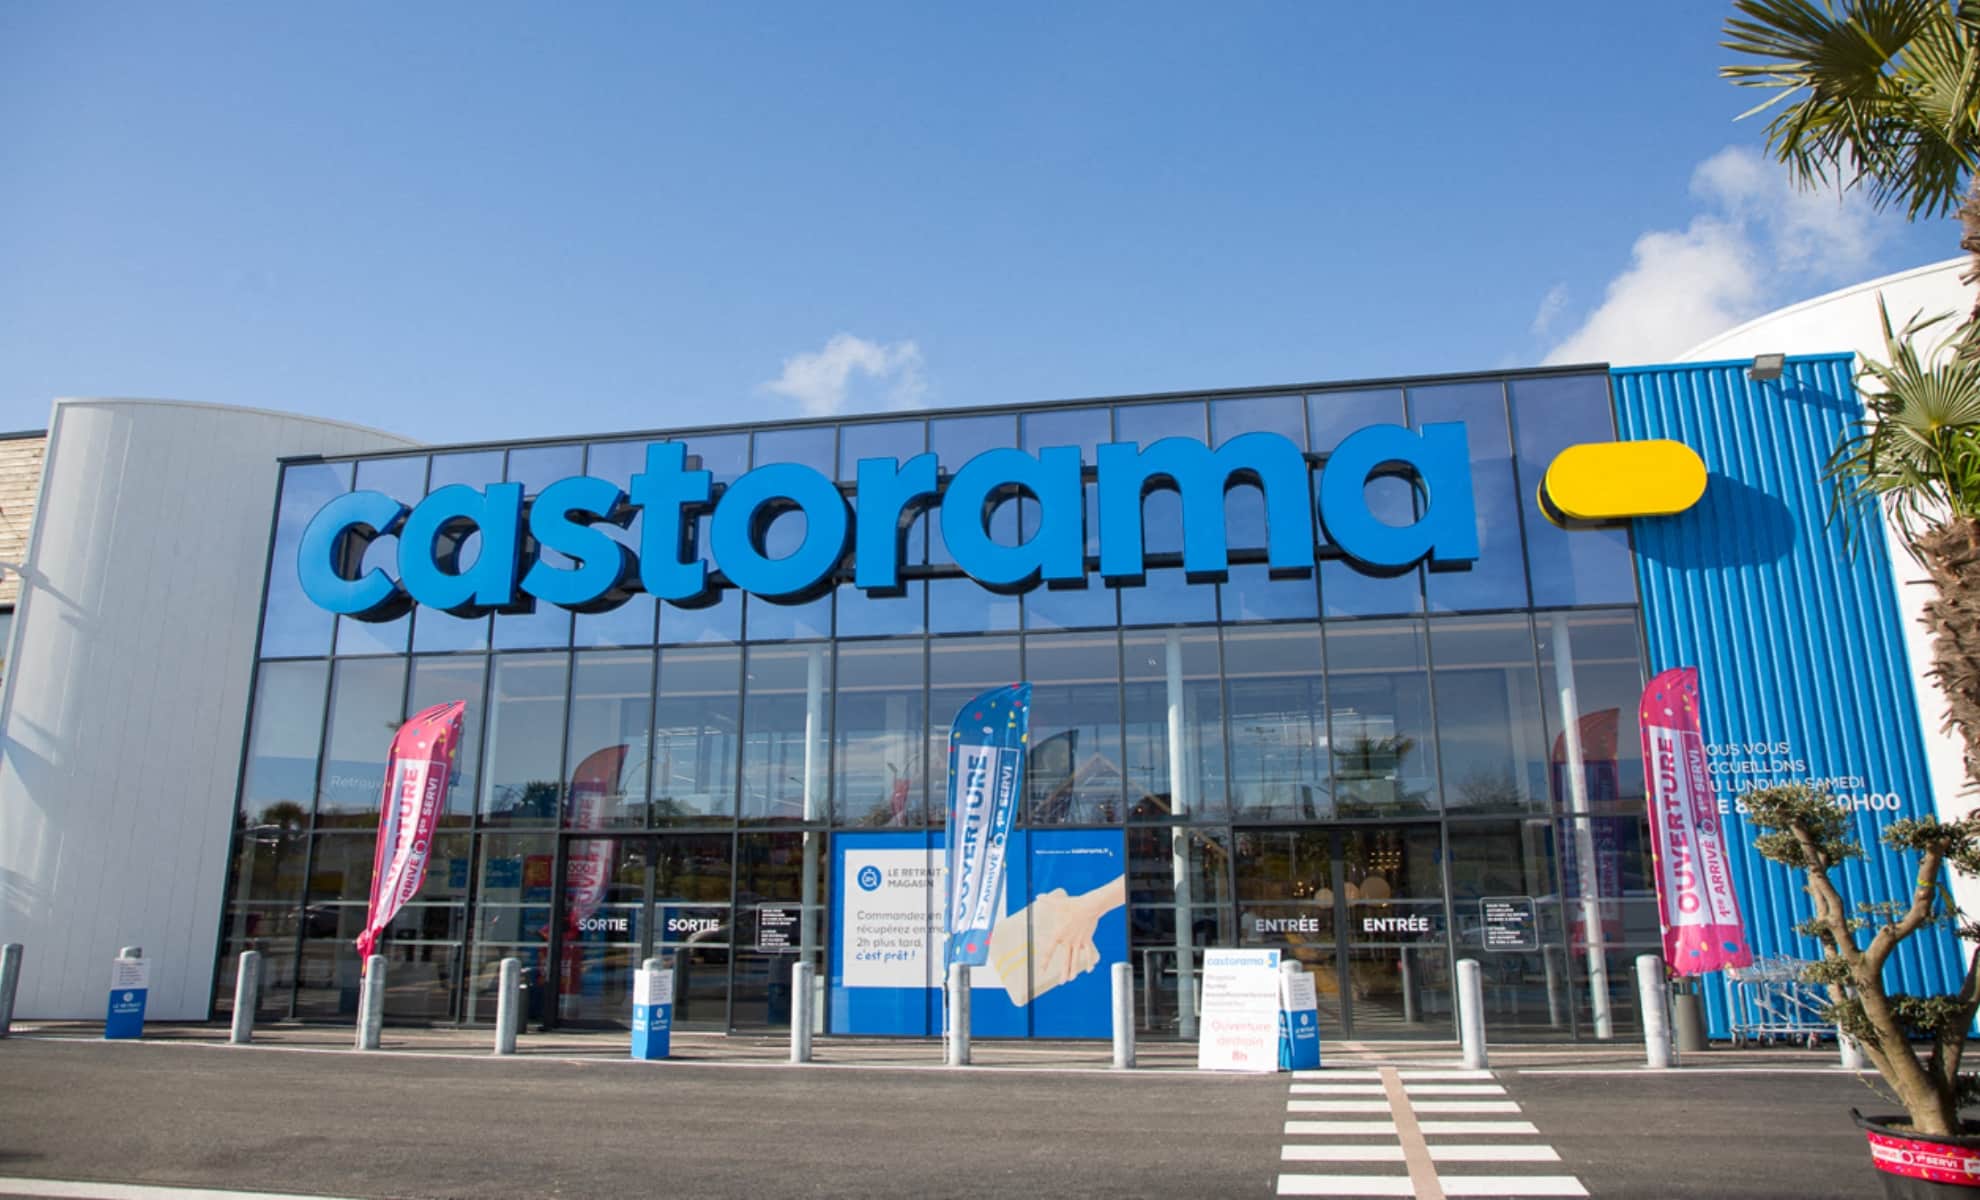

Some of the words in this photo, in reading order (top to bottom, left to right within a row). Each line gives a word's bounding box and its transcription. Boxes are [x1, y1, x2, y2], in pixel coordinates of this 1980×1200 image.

[297, 419, 1480, 619] castorama
[1706, 743, 1741, 757] OUS
[1743, 741, 1790, 755] VOUS
[1688, 749, 1705, 792] SERVI
[1708, 759, 1806, 774] CCUEILLONS
[999, 766, 1013, 807] SERVI
[1726, 778, 1774, 793] LUNDI
[1804, 776, 1865, 792] SAMEDI
[421, 777, 440, 818] SERVI
[1657, 736, 1701, 915] OUVERTURE
[378, 767, 419, 908] VERTURE
[958, 755, 988, 920] OUVERTURE
[887, 868, 900, 877] LE
[901, 868, 942, 877] RETRAIT
[1702, 841, 1726, 895] ARRIVÉ
[887, 879, 934, 888] MAGASIN
[856, 911, 926, 921] Commandez
[1255, 914, 1319, 932] ENTRÉE
[1363, 914, 1429, 932] ENTRÉE
[578, 918, 628, 931] SORTIE
[667, 918, 720, 931] SORTIE
[856, 924, 911, 935] récupérez
[856, 937, 871, 948] 2h
[873, 937, 896, 949] plus
[884, 949, 908, 964] prêt
[1207, 956, 1264, 967] castorama
[1926, 1157, 1958, 1168] SERVI
